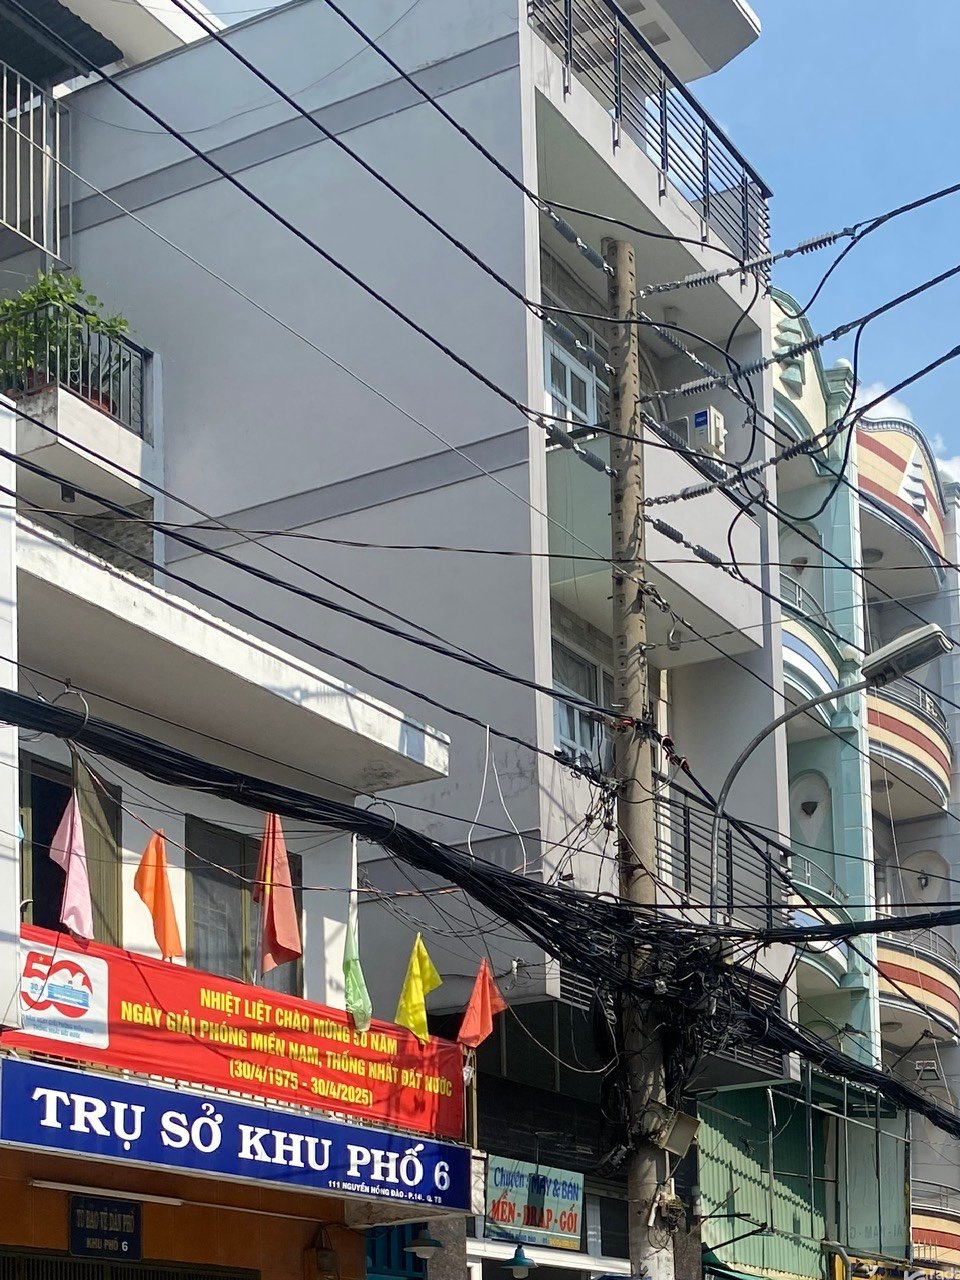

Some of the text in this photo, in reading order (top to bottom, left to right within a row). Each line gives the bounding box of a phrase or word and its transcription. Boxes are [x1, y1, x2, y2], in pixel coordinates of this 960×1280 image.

[200, 988, 397, 1056] NHIỆT LIỆT CHÀO MỪNG 50 NĂM
[121, 1001, 452, 1097] NGÀY GIẢI PHÓNG MIỀN NAM, THỐNG NHẤT ĐẤT NƯỚC
[229, 1059, 299, 1090] (30/4/1975
[311, 1077, 373, 1108] 30/4/2025)
[31, 1087, 450, 1191] TRỤ SỞ KHU PHỐ 6
[328, 1180, 340, 1188] 111
[342, 1181, 369, 1193] NGUYỄN
[391, 1187, 404, 1198] ĐÀO
[494, 1166, 525, 1192] Chuyên
[531, 1175, 551, 1197] MAY
[552, 1179, 560, 1198] &
[561, 1177, 579, 1201] BÁN
[523, 1204, 553, 1229] DRAP
[560, 1204, 578, 1233] GỐI
[121, 1241, 129, 1252] 6
